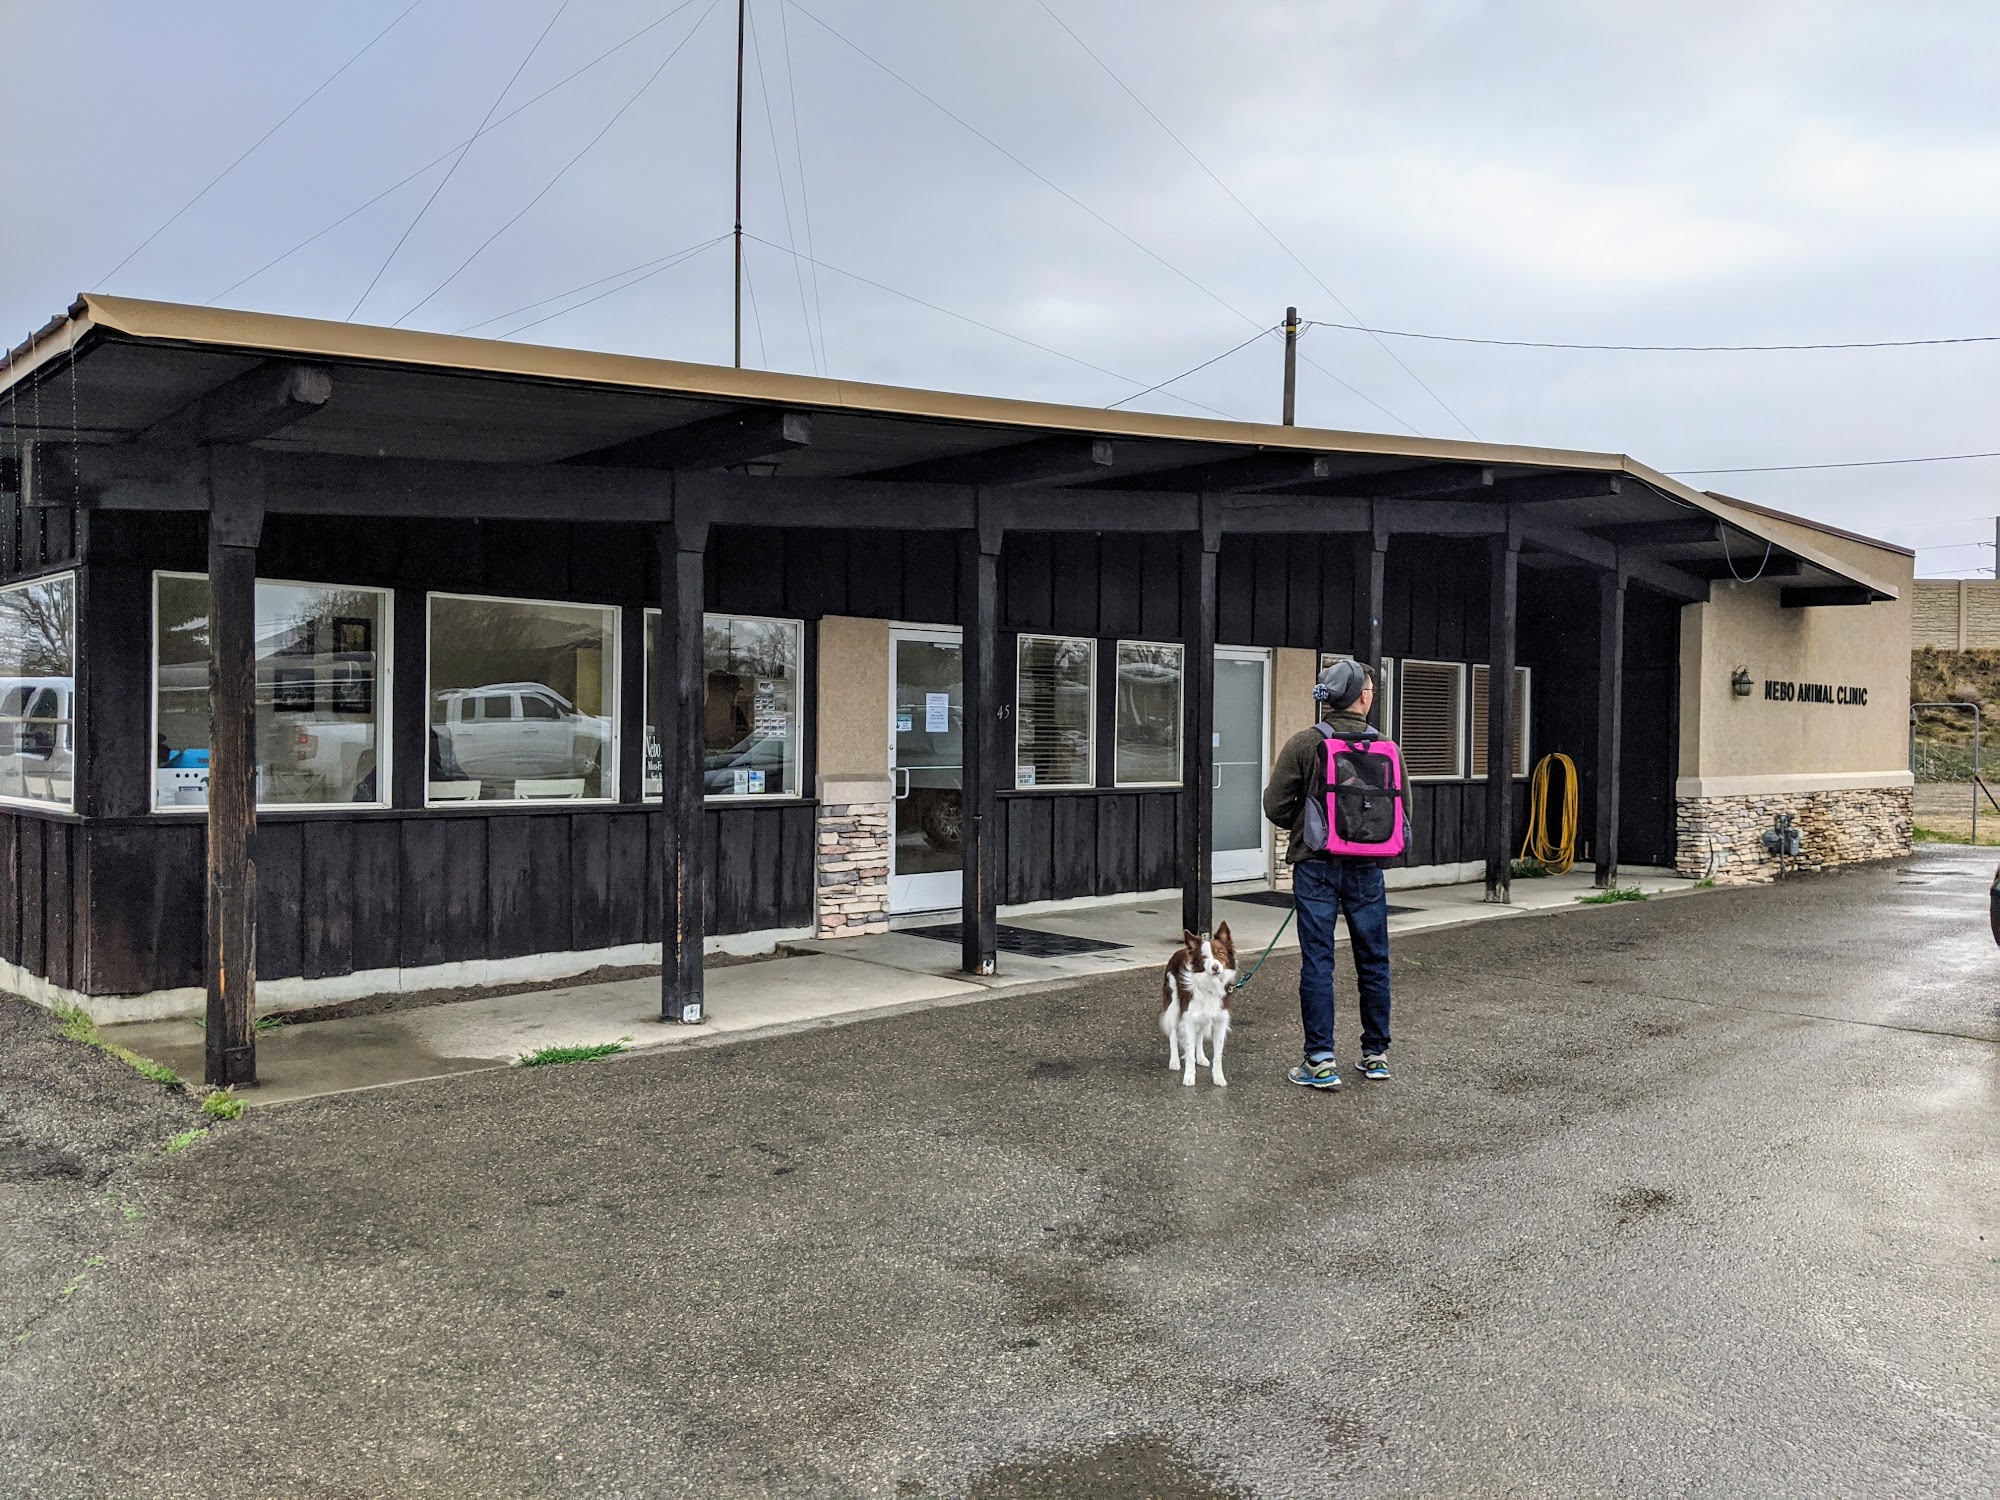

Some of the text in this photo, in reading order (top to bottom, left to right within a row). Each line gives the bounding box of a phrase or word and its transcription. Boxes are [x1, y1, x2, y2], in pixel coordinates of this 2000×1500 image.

[1765, 680, 1868, 706] NEBO ANIMAL CLINIC
[997, 704, 1010, 720] 45
[646, 736, 661, 757] Nebo
